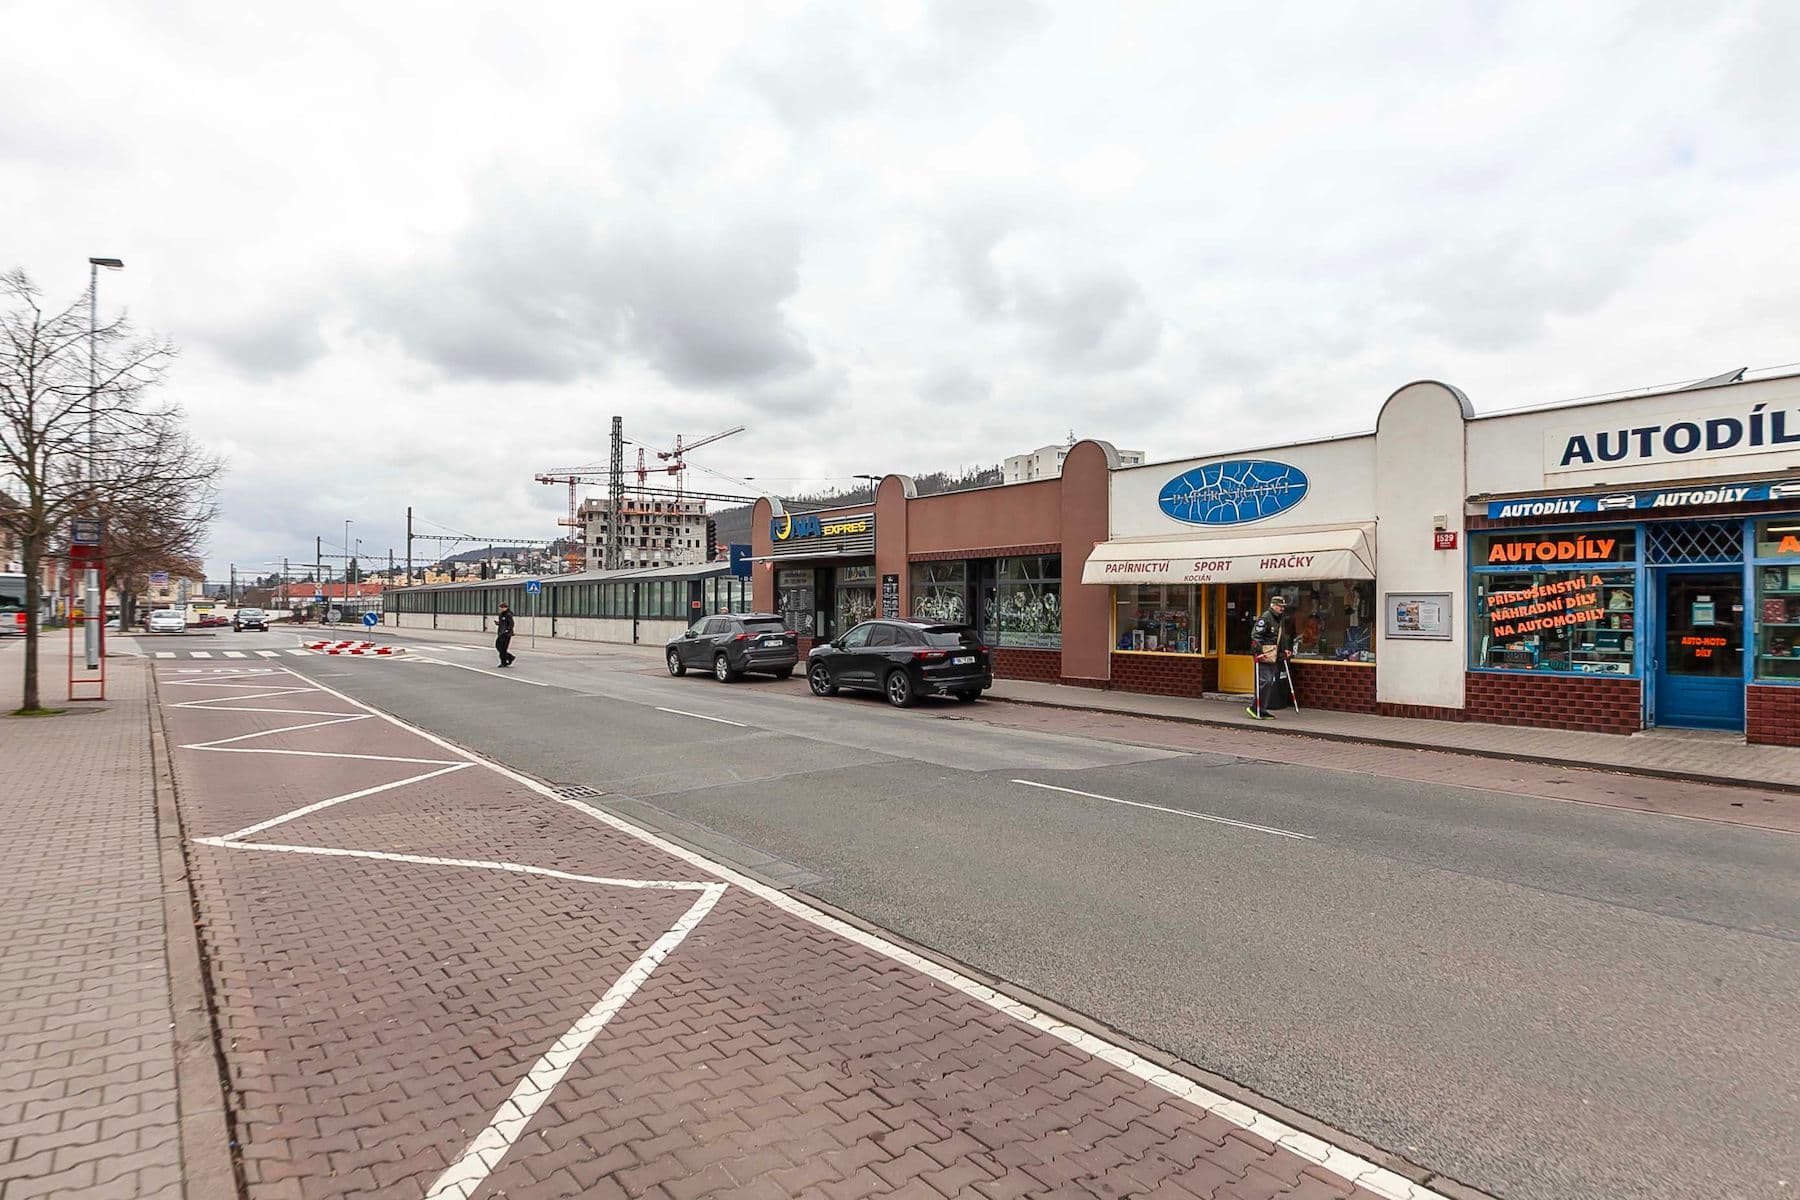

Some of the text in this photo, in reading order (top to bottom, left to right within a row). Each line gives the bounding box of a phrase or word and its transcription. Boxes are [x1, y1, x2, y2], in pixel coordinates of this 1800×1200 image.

[1559, 402, 1800, 467] AUTODÍL
[1652, 486, 1751, 508] AUTODÍLY
[1499, 498, 1582, 519] AUTODÍLY
[823, 520, 867, 537] EXPRES
[1436, 534, 1455, 543] 1529
[1488, 535, 1616, 563] AUTODÍLY
[1105, 554, 1315, 574] PAPÍRNICTVÍ SPORT HRAČKY
[1183, 574, 1213, 583] KOCIÁN
[1591, 574, 1604, 587] A
[1490, 592, 1597, 622] NÁHRADNÍ DÍLY
[1494, 607, 1606, 638] NA AUTOMOBILY
